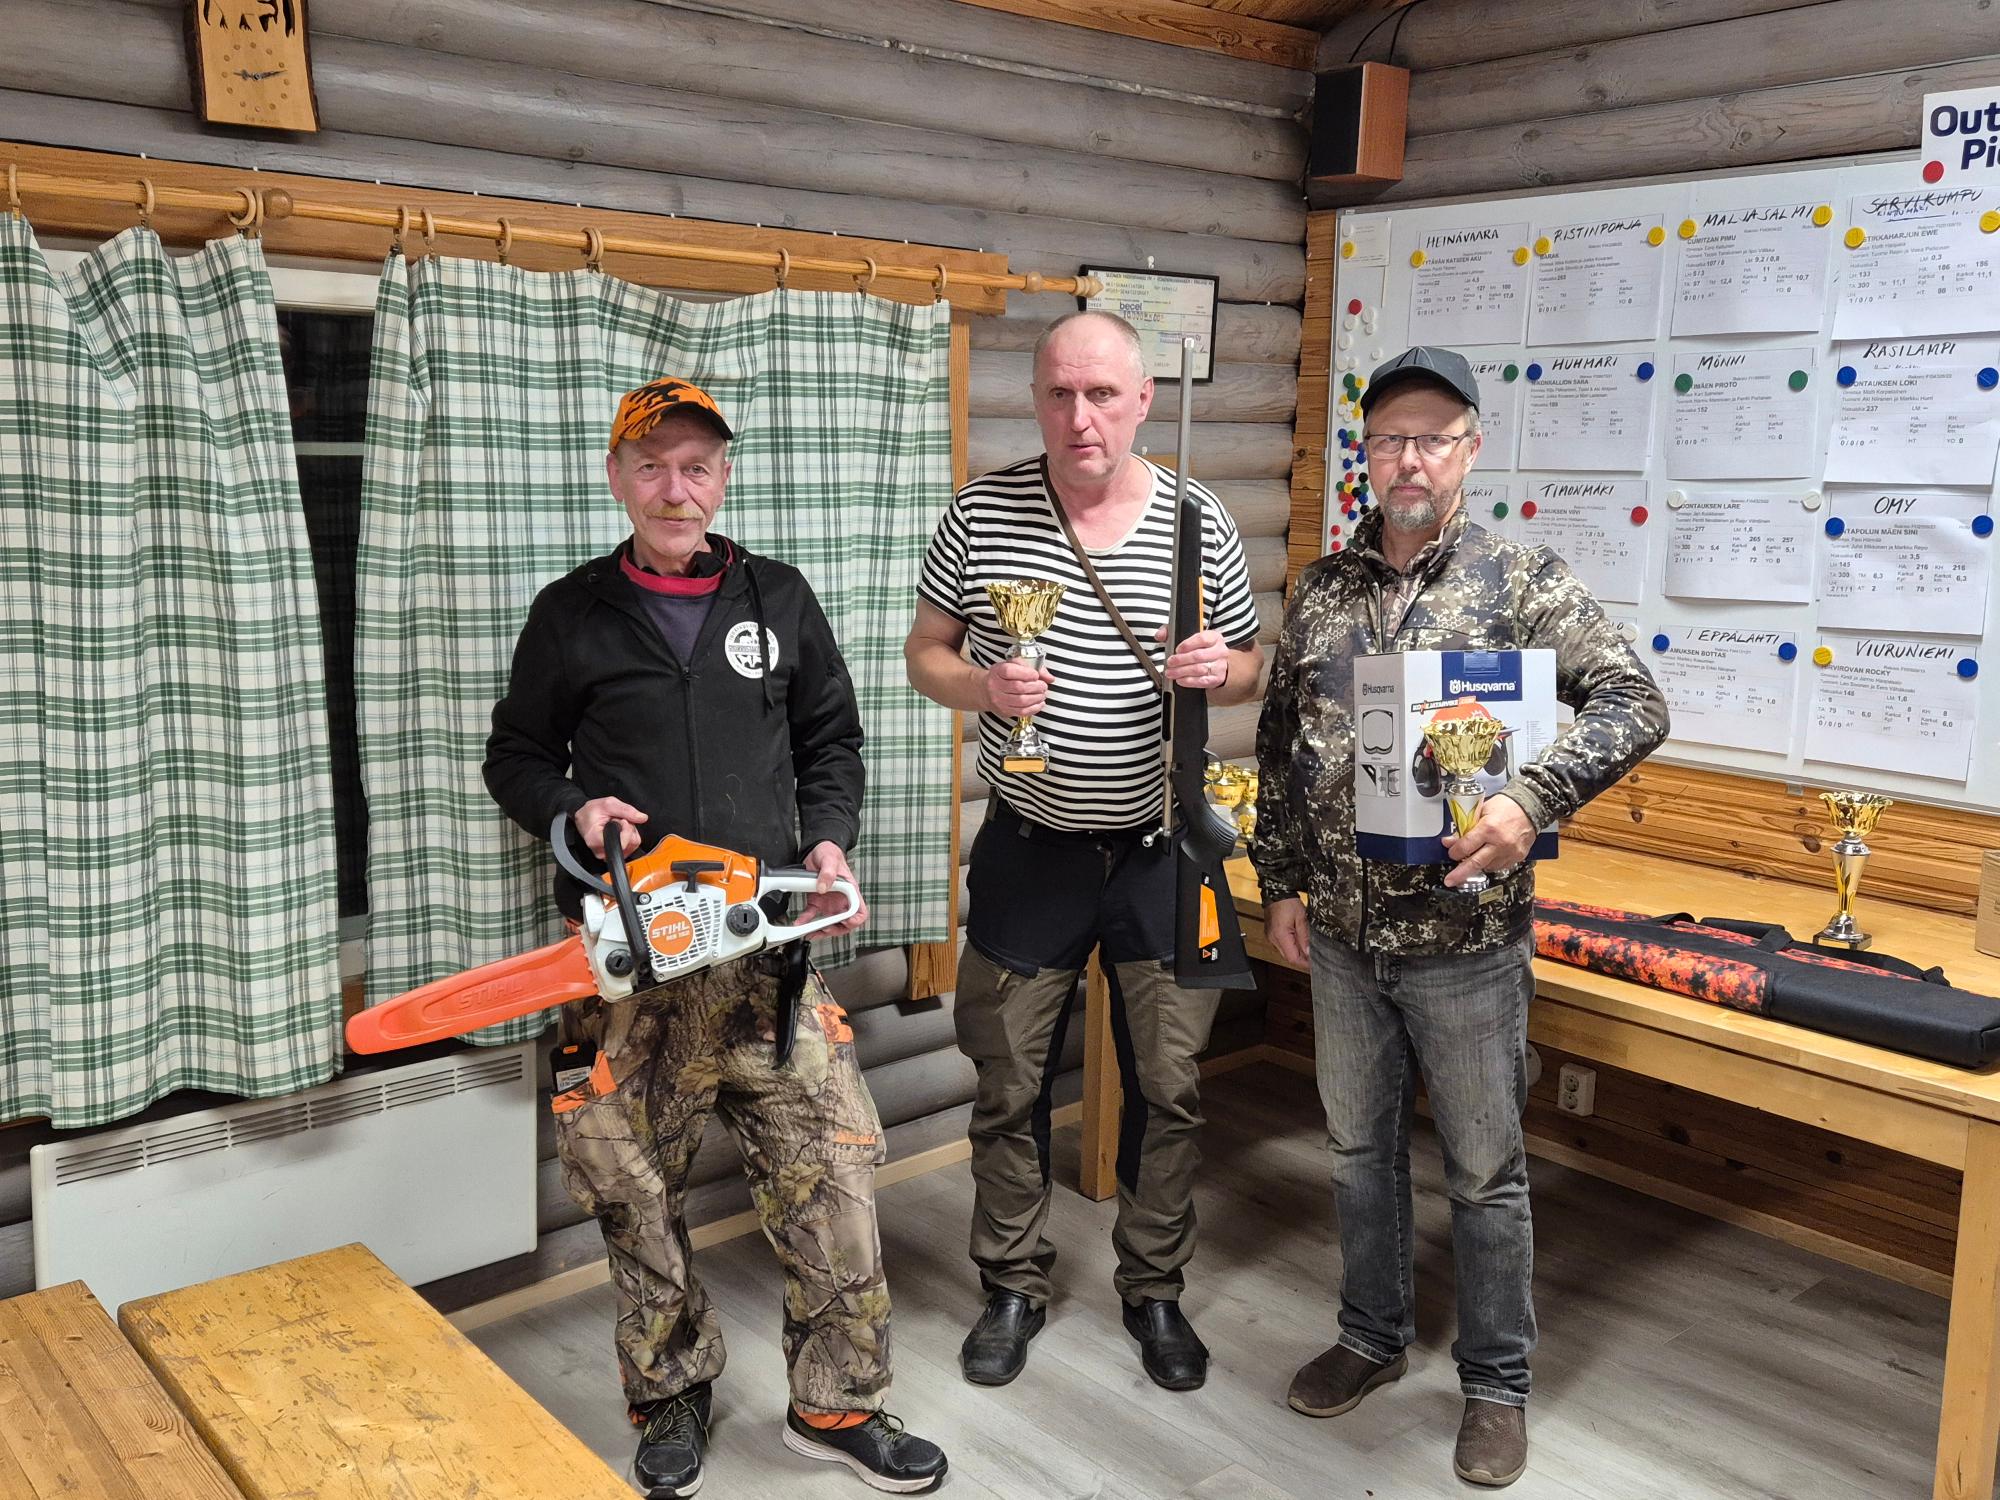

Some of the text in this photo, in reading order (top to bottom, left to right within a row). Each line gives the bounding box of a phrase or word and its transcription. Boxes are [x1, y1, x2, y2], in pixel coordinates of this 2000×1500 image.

[1961, 136, 2000, 170] Pi
[1704, 206, 1814, 227] MALJASALMI
[1426, 229, 1498, 248] HEINÄVAARA
[1554, 220, 1641, 243] RISTINPOHJA
[1552, 356, 1618, 370] HUHMARI
[1698, 355, 1745, 370] MÖNNI
[1466, 486, 1493, 496] JÄRVI
[1540, 483, 1614, 497] TIMONMÄKI
[1874, 496, 1917, 514] OMY
[1856, 640, 1955, 659] VIURUNIEMI
[1865, 668, 1891, 677] ROCKY
[1368, 684, 1395, 695] Husqvarna
[1462, 681, 1516, 692] Husqvarna
[651, 920, 690, 938] STIHL
[458, 981, 524, 1011] STIHL
